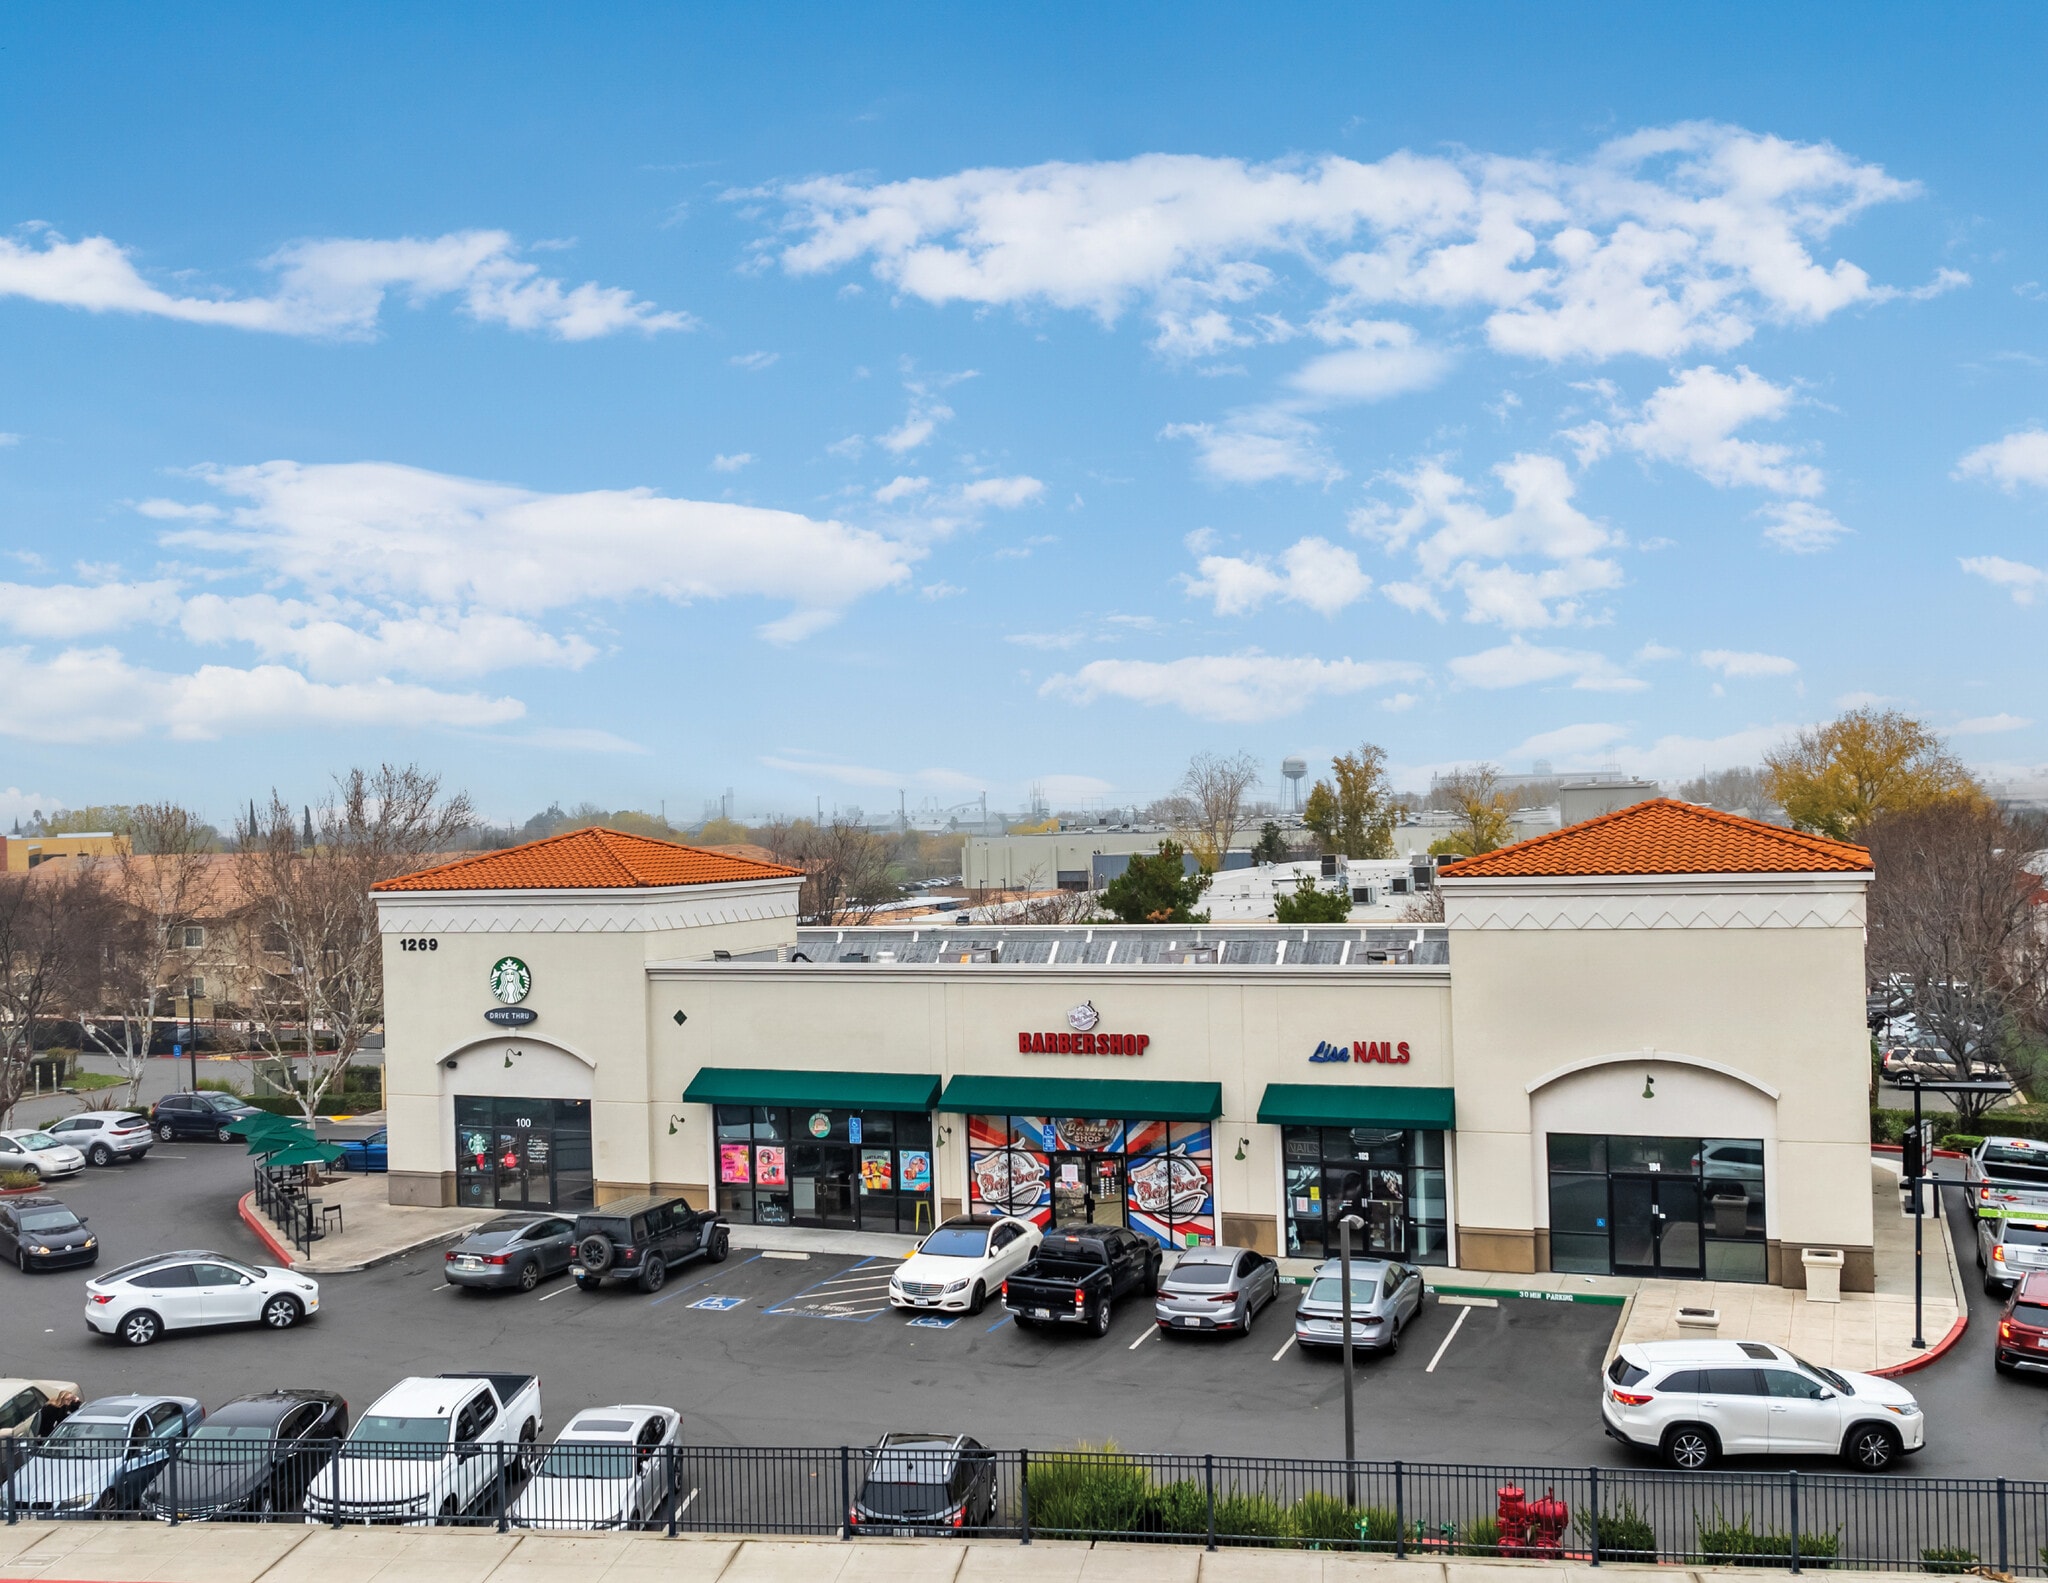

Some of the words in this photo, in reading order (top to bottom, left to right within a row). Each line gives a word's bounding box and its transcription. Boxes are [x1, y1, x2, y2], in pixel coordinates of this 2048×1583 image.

[400, 938, 438, 951] 1269
[1018, 1033, 1149, 1055] BARBERSHOP
[1308, 1040, 1351, 1063] Lisa
[1353, 1041, 1410, 1064] NAILS
[516, 1118, 531, 1128] 100
[1064, 1122, 1110, 1136] Barber
[1289, 1143, 1320, 1154] NAILS
[1648, 1162, 1660, 1171] 104
[1546, 1293, 1573, 1302] PARKING
